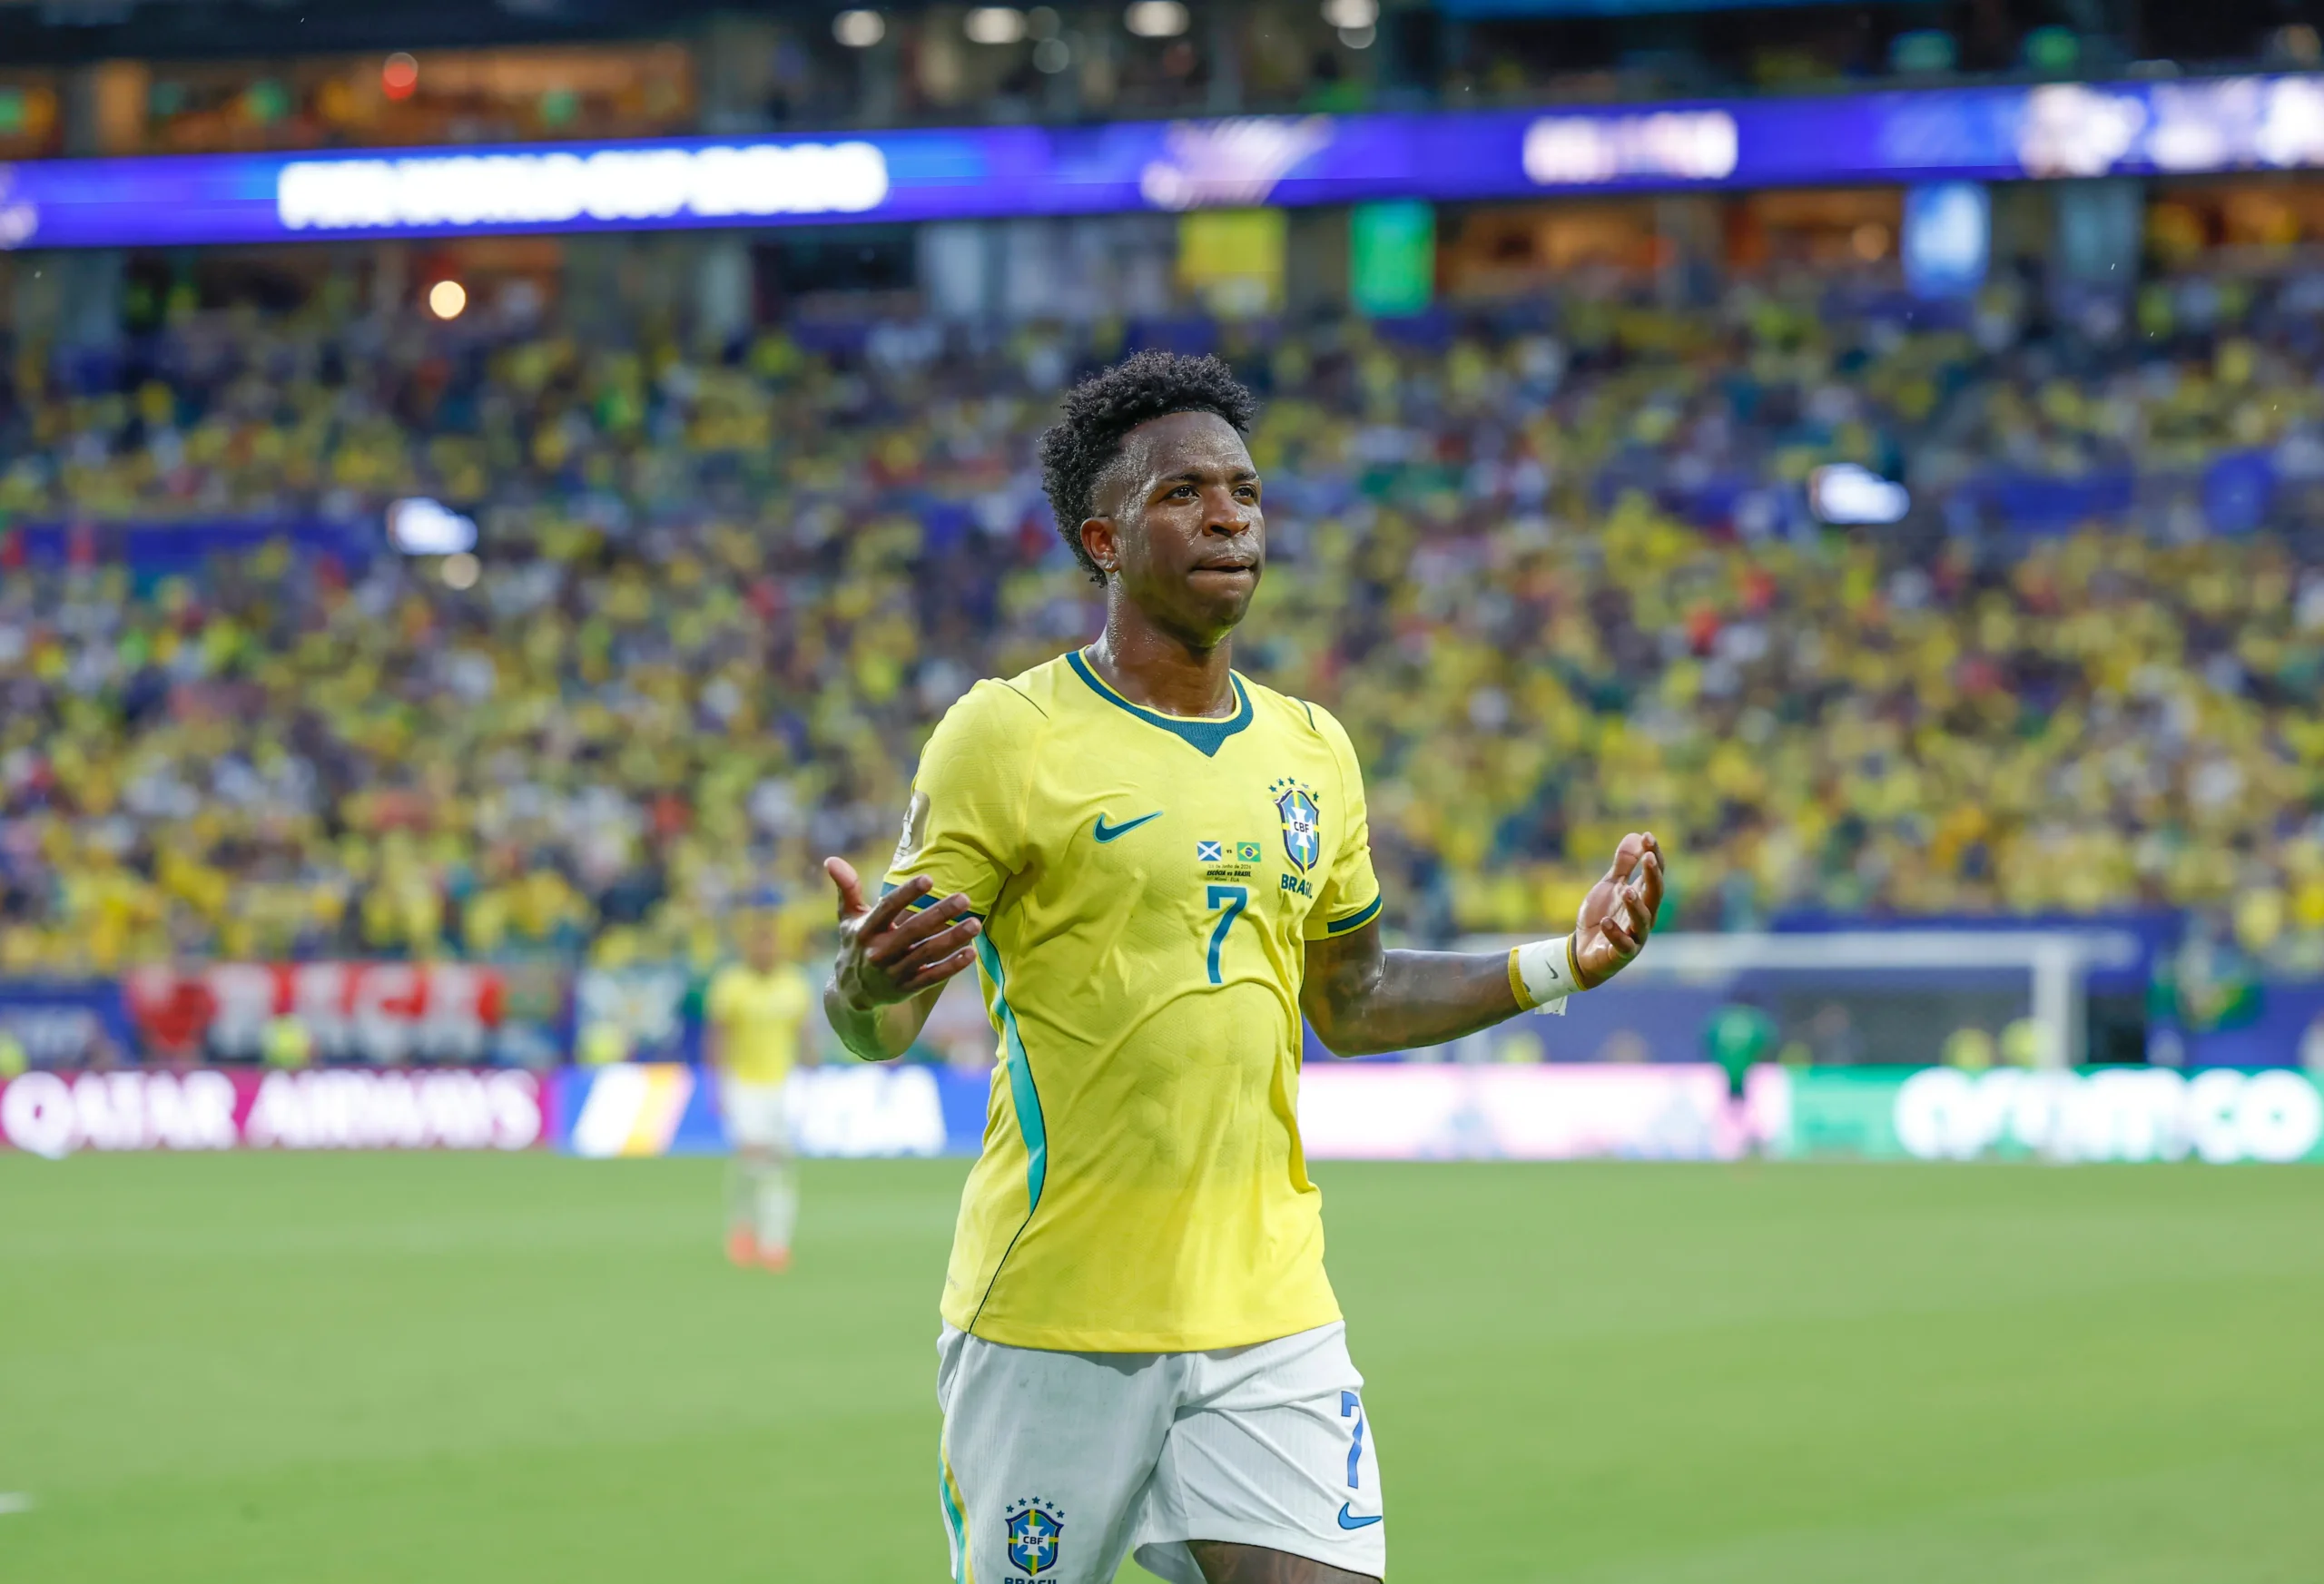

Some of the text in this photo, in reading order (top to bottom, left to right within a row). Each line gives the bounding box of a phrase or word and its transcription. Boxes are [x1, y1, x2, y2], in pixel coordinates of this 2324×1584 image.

[1294, 822, 1309, 832] CBF
[1206, 885, 1247, 985] 7
[2, 1068, 541, 1158] QATAR AIRWAYS
[1341, 1391, 1364, 1490] 7
[1023, 1536, 1044, 1545] CBF
